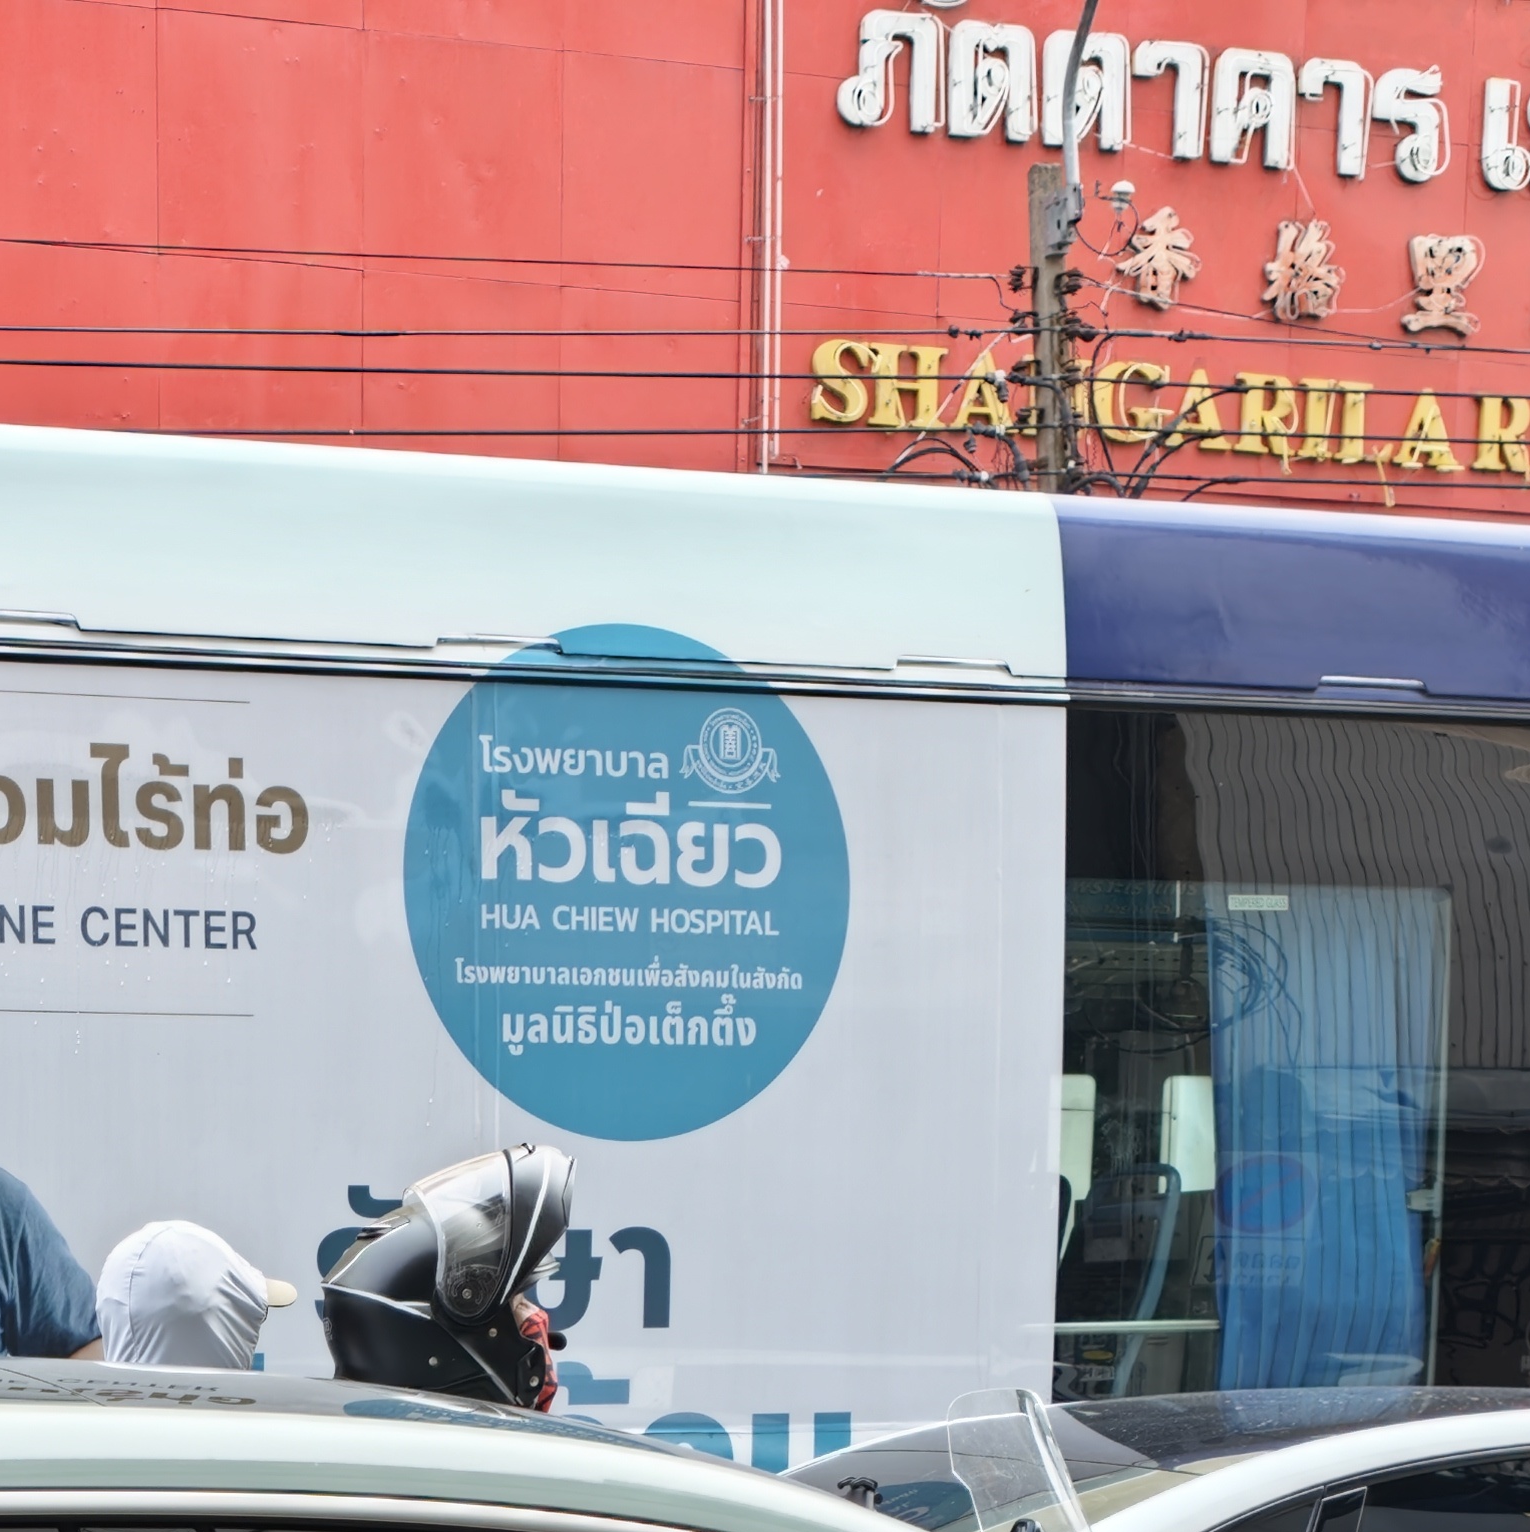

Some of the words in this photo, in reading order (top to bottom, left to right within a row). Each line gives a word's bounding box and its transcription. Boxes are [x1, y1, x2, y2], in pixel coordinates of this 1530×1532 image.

[837, 0, 1450, 184] ภตตาคาร
[479, 735, 669, 779] โรงพยาบาล
[481, 788, 782, 888] หัวเฉียว
[79, 904, 259, 951] CENTER
[481, 904, 540, 930] HUA
[552, 905, 638, 933] CHIEW
[651, 910, 780, 936] HOSPITAL
[455, 956, 803, 991] โรงพยาบาลเอกชนเพื่อสังคมในสังกัด
